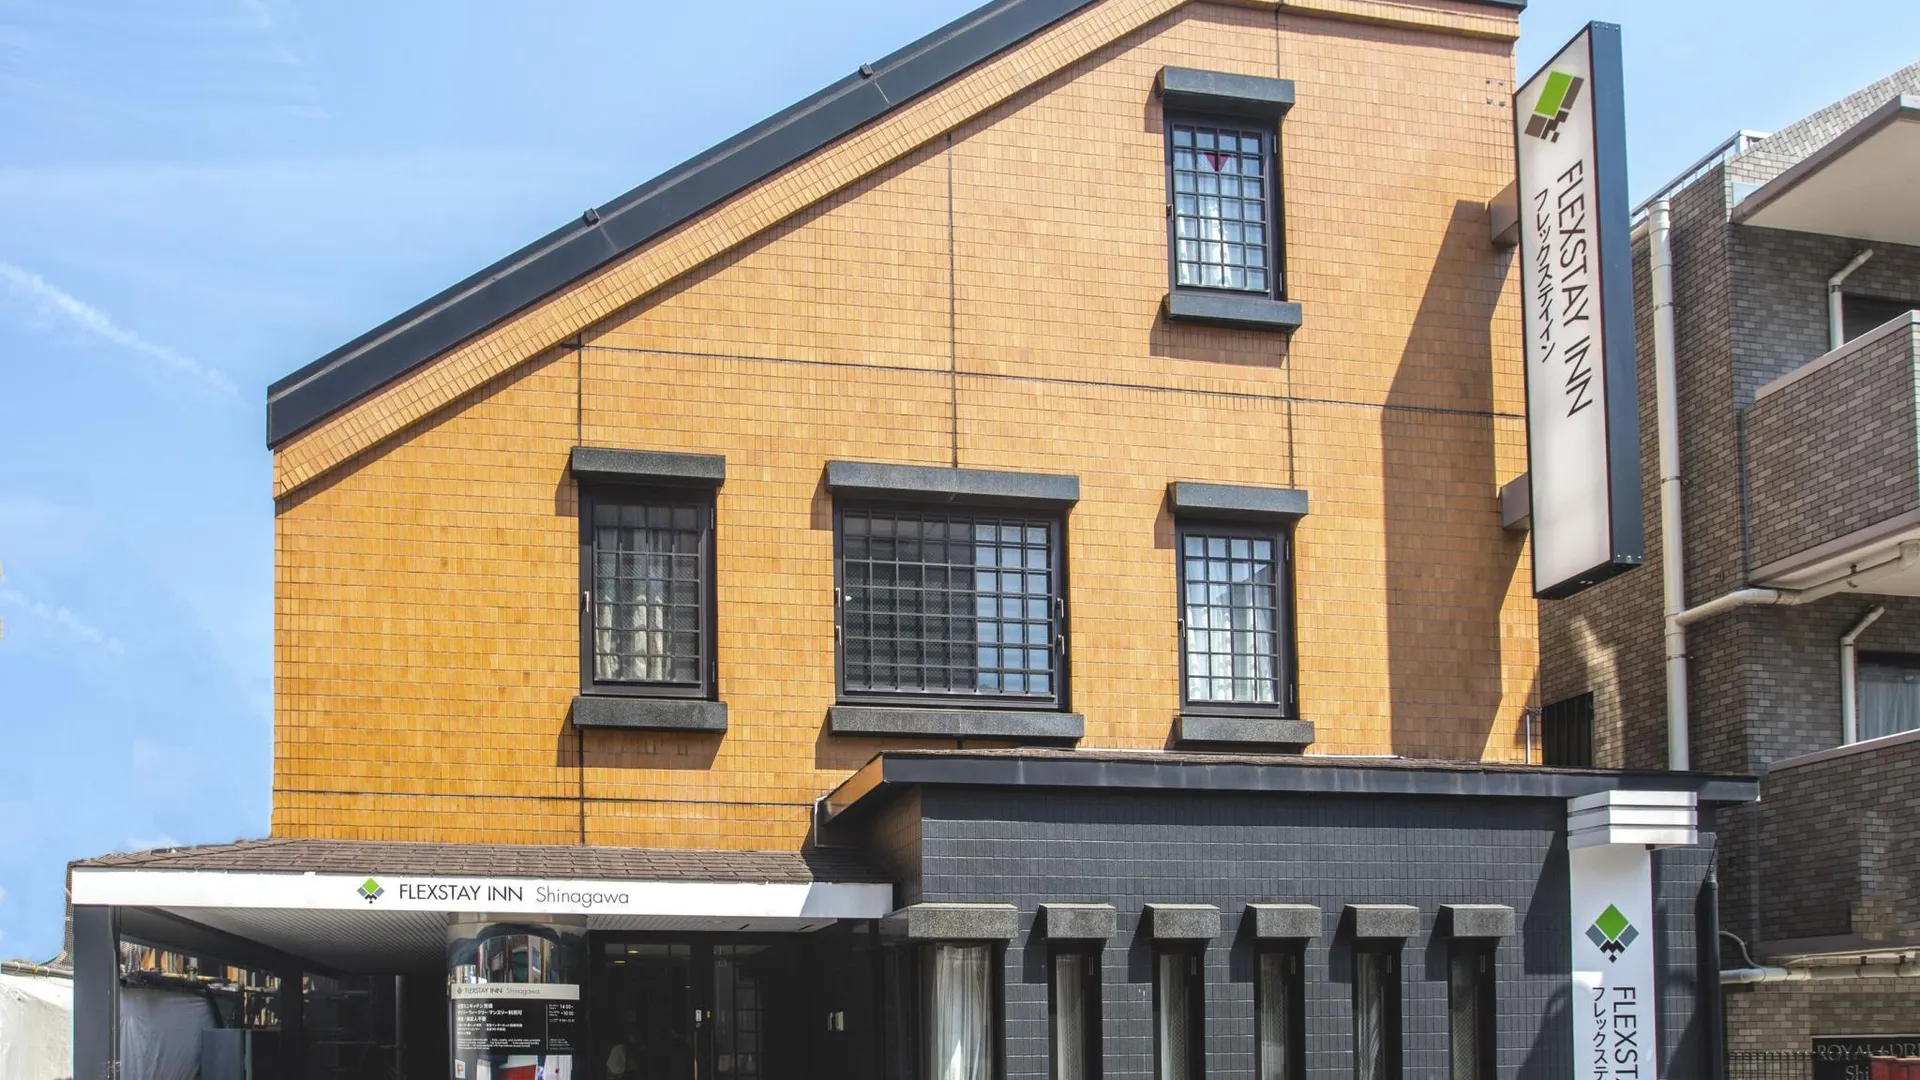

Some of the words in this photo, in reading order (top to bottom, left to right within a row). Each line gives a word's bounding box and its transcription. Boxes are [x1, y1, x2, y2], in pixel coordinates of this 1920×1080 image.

[1534, 188, 1556, 363] フレックステイイン
[1557, 159, 1589, 327] FLEXSTAY
[1564, 335, 1593, 418] INN
[399, 884, 481, 901] FLEXSTAY
[488, 886, 523, 902] INN
[536, 886, 629, 908] Shinagawa
[1613, 987, 1638, 1080] FLEXST
[1817, 1044, 1873, 1060] ROYAL
